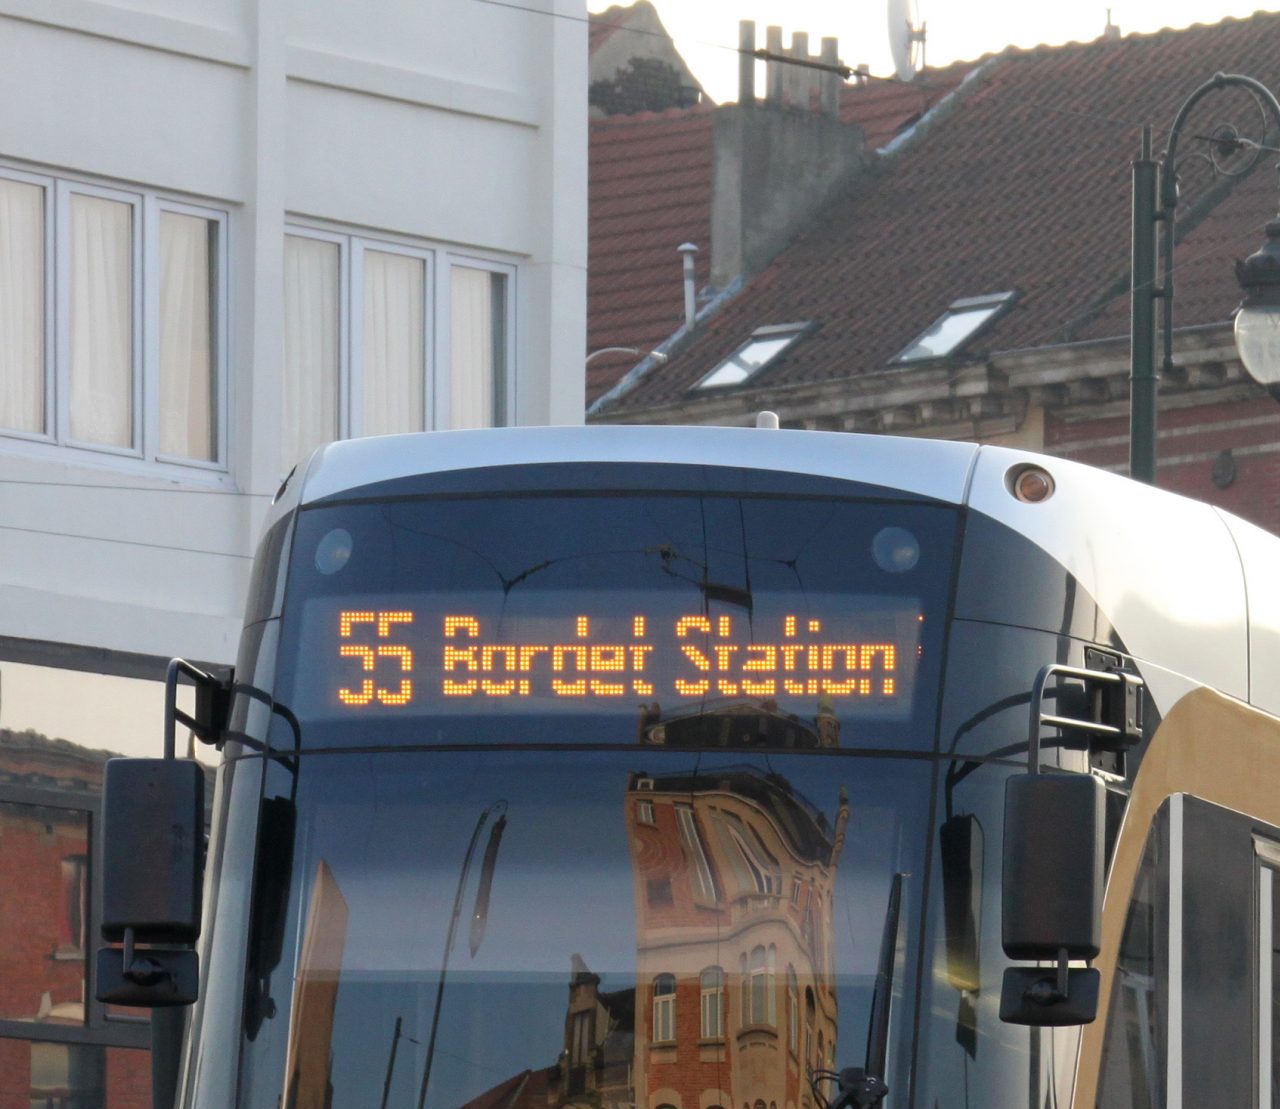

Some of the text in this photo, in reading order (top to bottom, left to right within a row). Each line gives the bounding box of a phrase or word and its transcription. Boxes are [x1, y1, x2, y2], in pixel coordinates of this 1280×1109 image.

[338, 610, 897, 706] 55 Bordet Station
